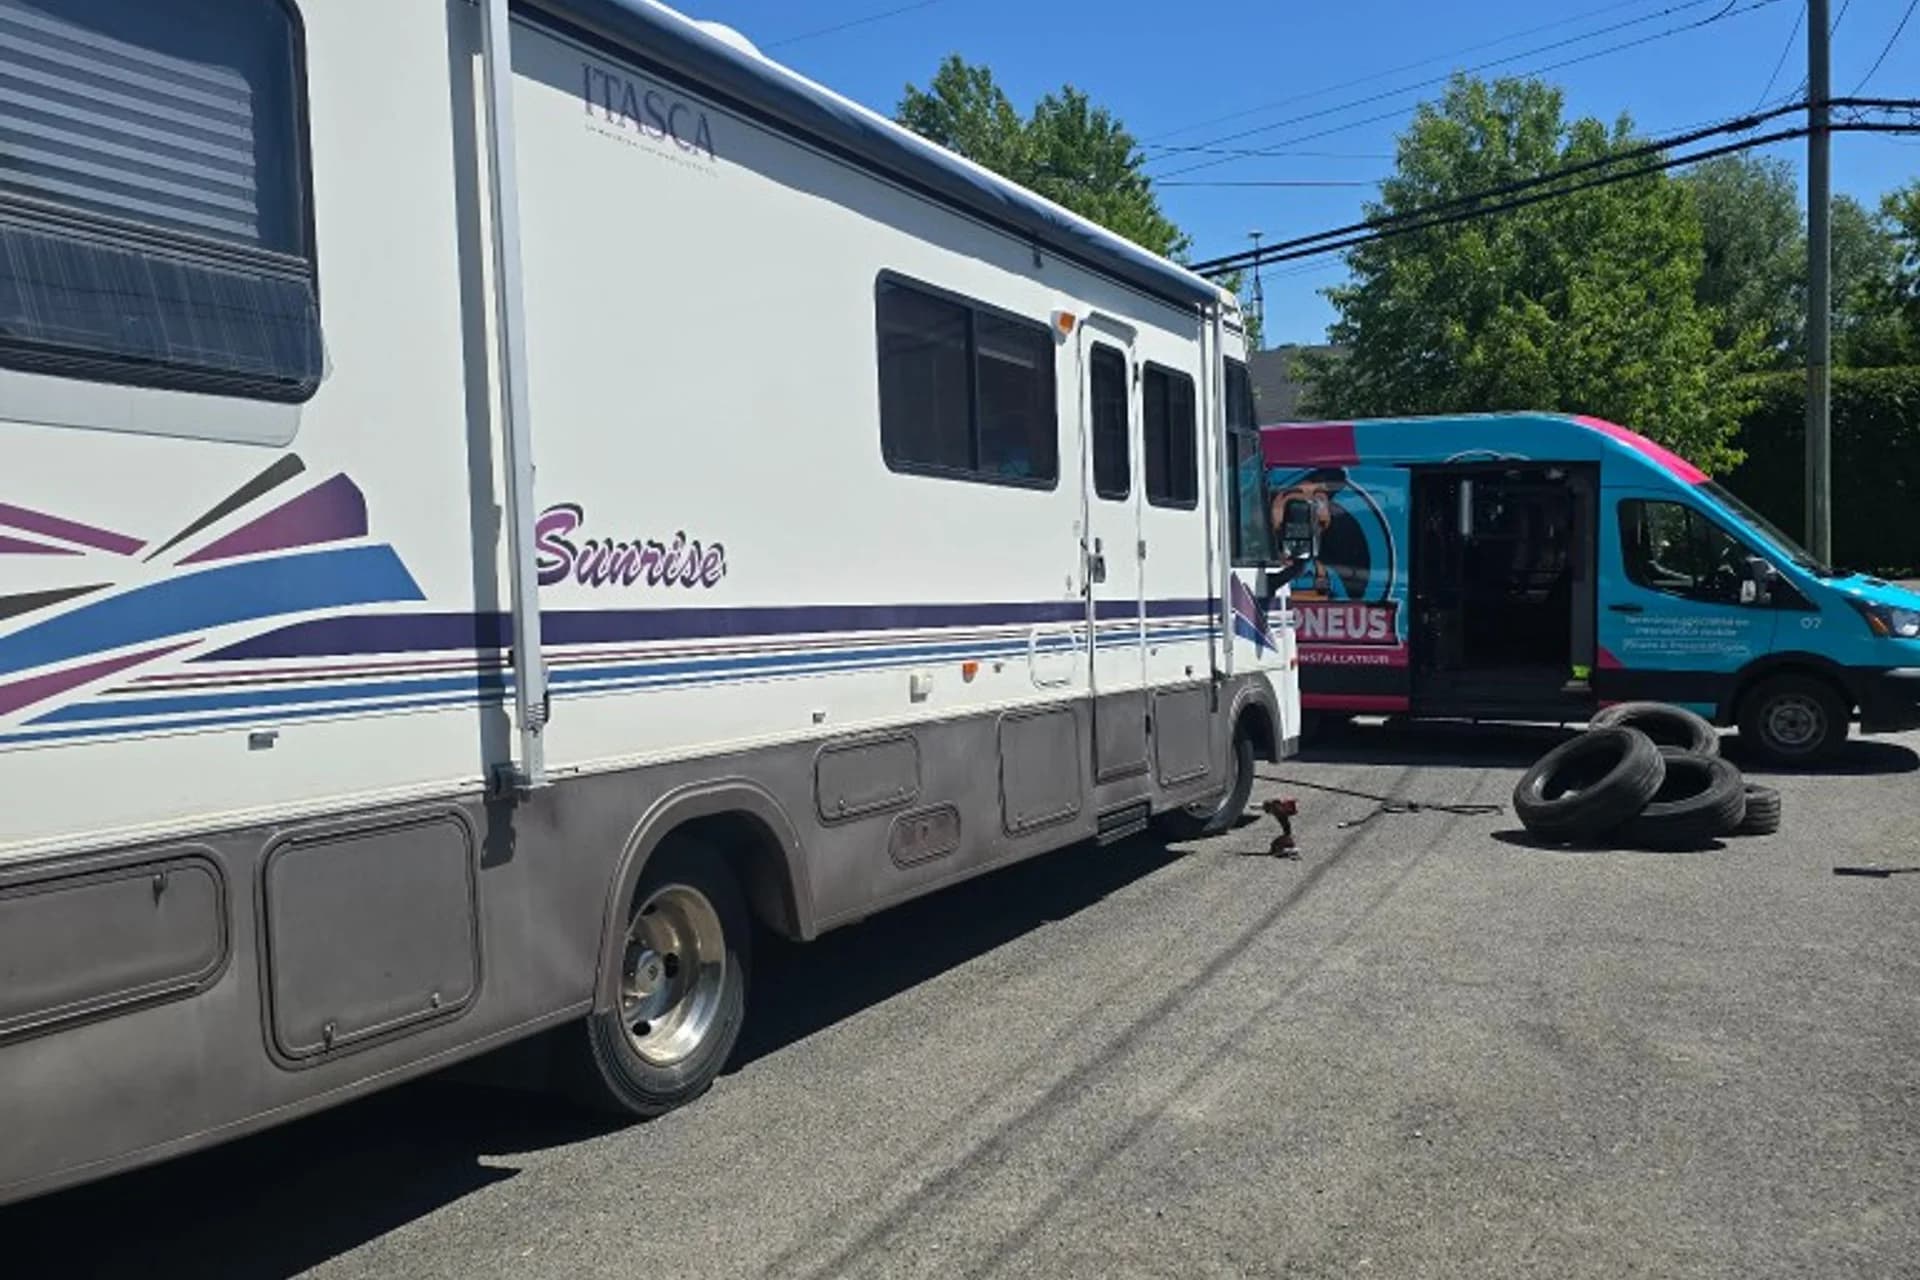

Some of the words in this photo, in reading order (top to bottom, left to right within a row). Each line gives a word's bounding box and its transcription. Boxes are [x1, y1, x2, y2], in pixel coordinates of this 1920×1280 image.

[581, 62, 716, 163] ITASCA
[535, 502, 727, 588] Sunrise
[1800, 616, 1823, 630] 07
[1299, 652, 1389, 665] NSTALLATEUR
